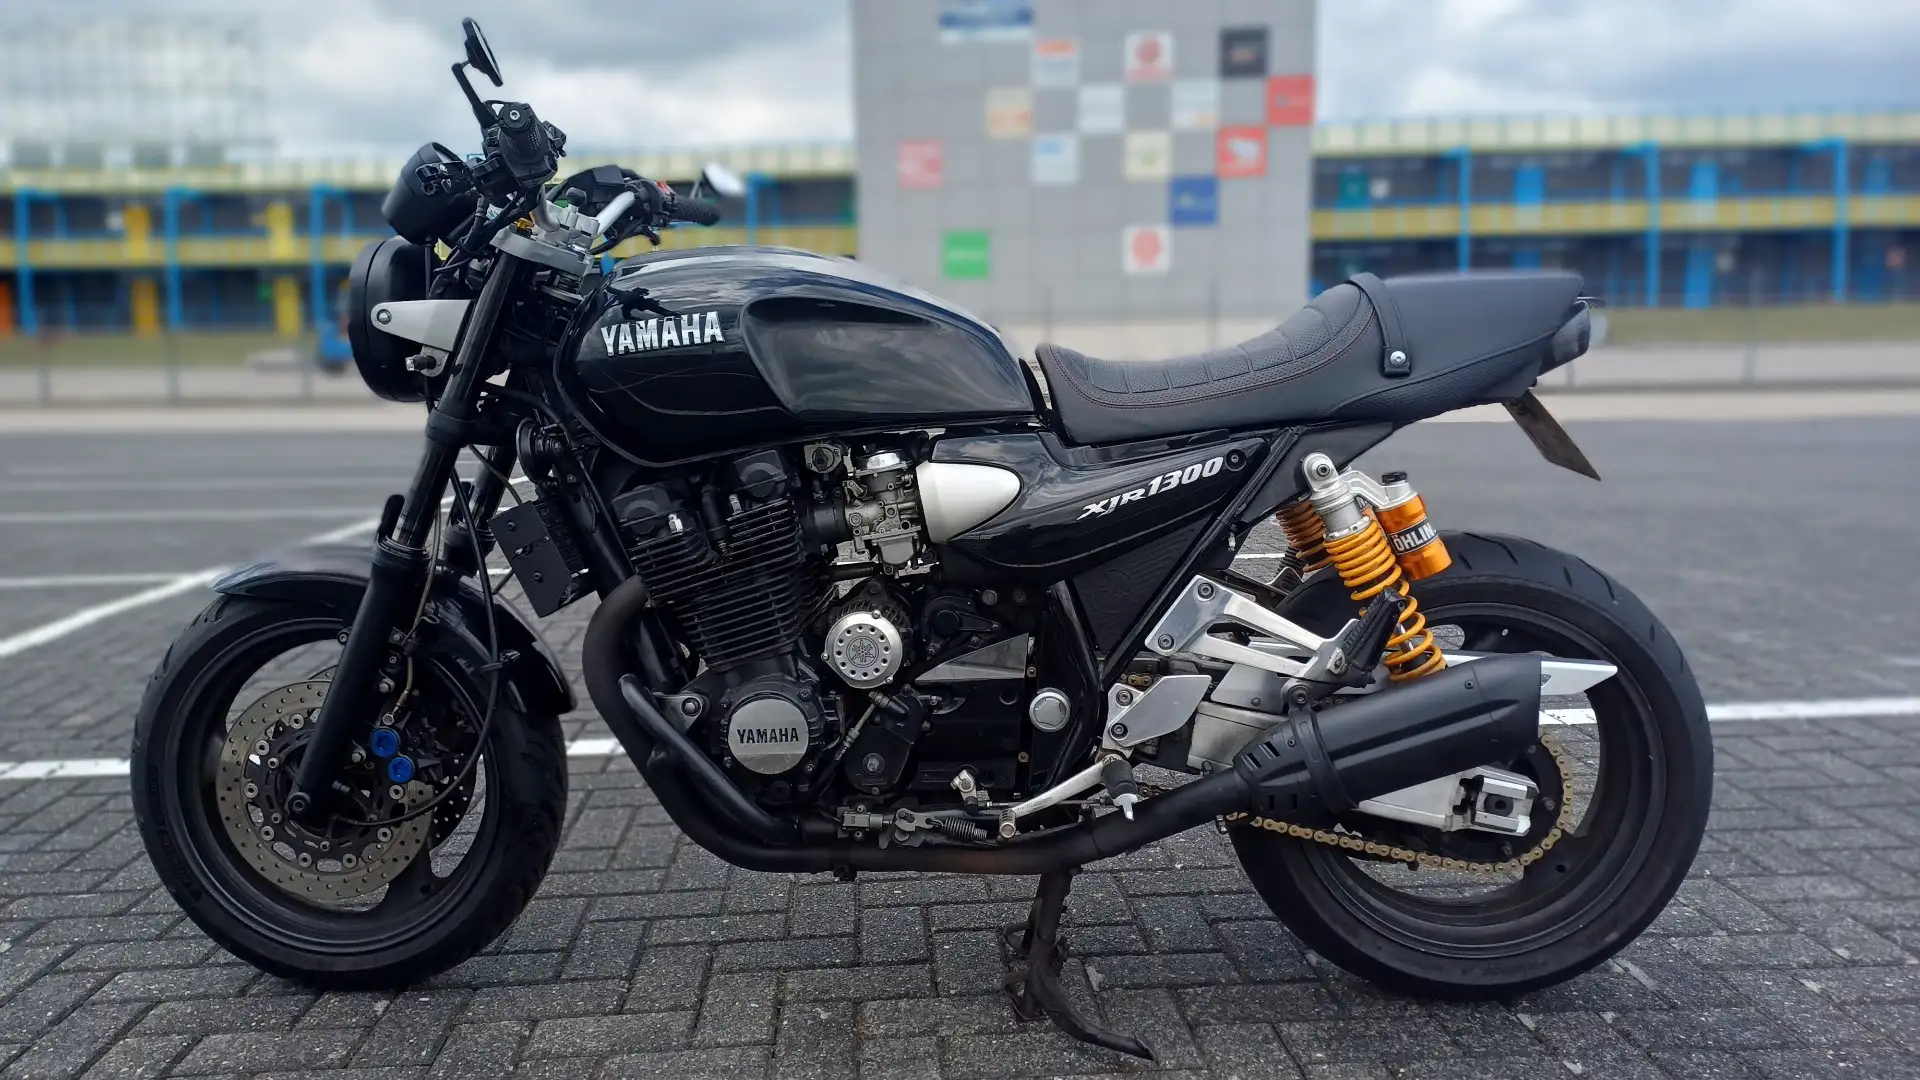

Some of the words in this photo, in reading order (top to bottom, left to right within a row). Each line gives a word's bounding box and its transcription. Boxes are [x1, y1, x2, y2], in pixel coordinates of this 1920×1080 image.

[601, 311, 725, 357] YAMAHA
[1076, 456, 1224, 521] XJR1300
[1391, 522, 1437, 552] ÖHLIN
[737, 727, 799, 743] YAMAHA
